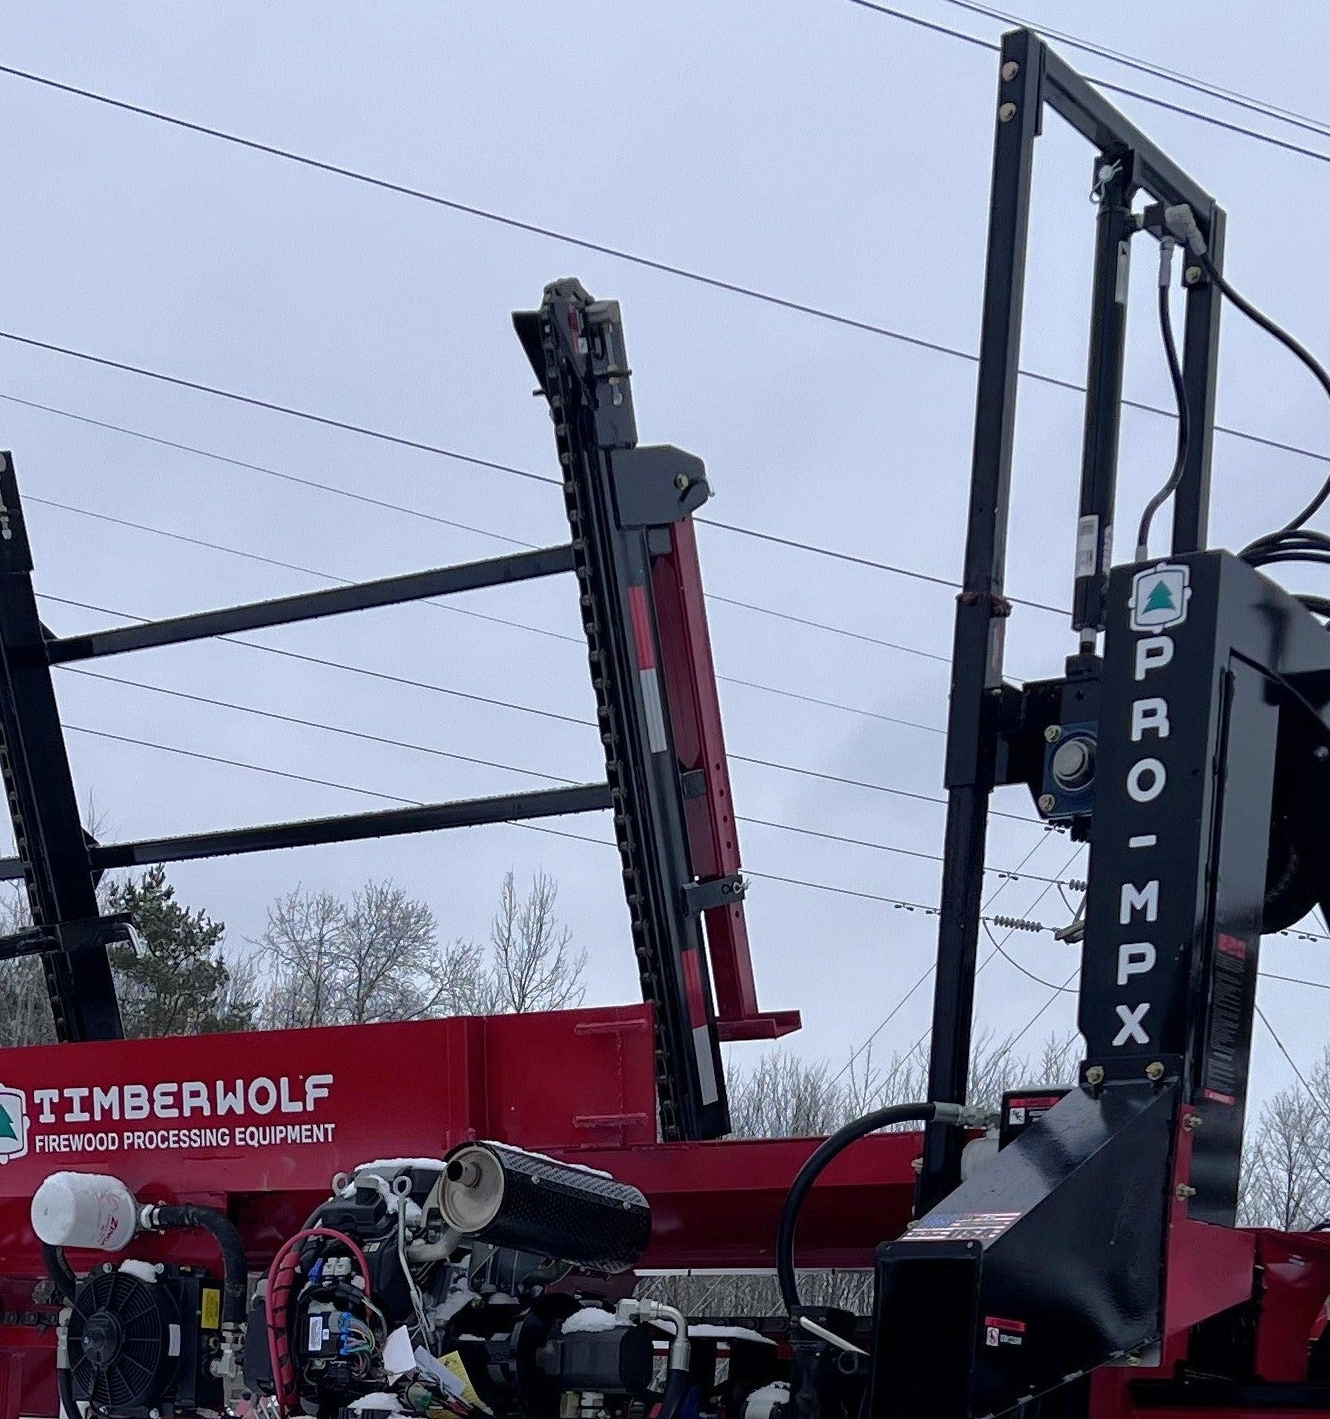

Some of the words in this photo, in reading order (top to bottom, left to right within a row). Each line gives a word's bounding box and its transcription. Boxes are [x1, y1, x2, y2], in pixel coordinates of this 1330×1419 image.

[1112, 636, 1174, 1046] PRO-MPX
[33, 1074, 334, 1123] TIMBERWOLF
[35, 1132, 119, 1153] FIREWOOD
[123, 1127, 230, 1150] PROCESSING
[235, 1123, 336, 1148] EQUIPMENT
